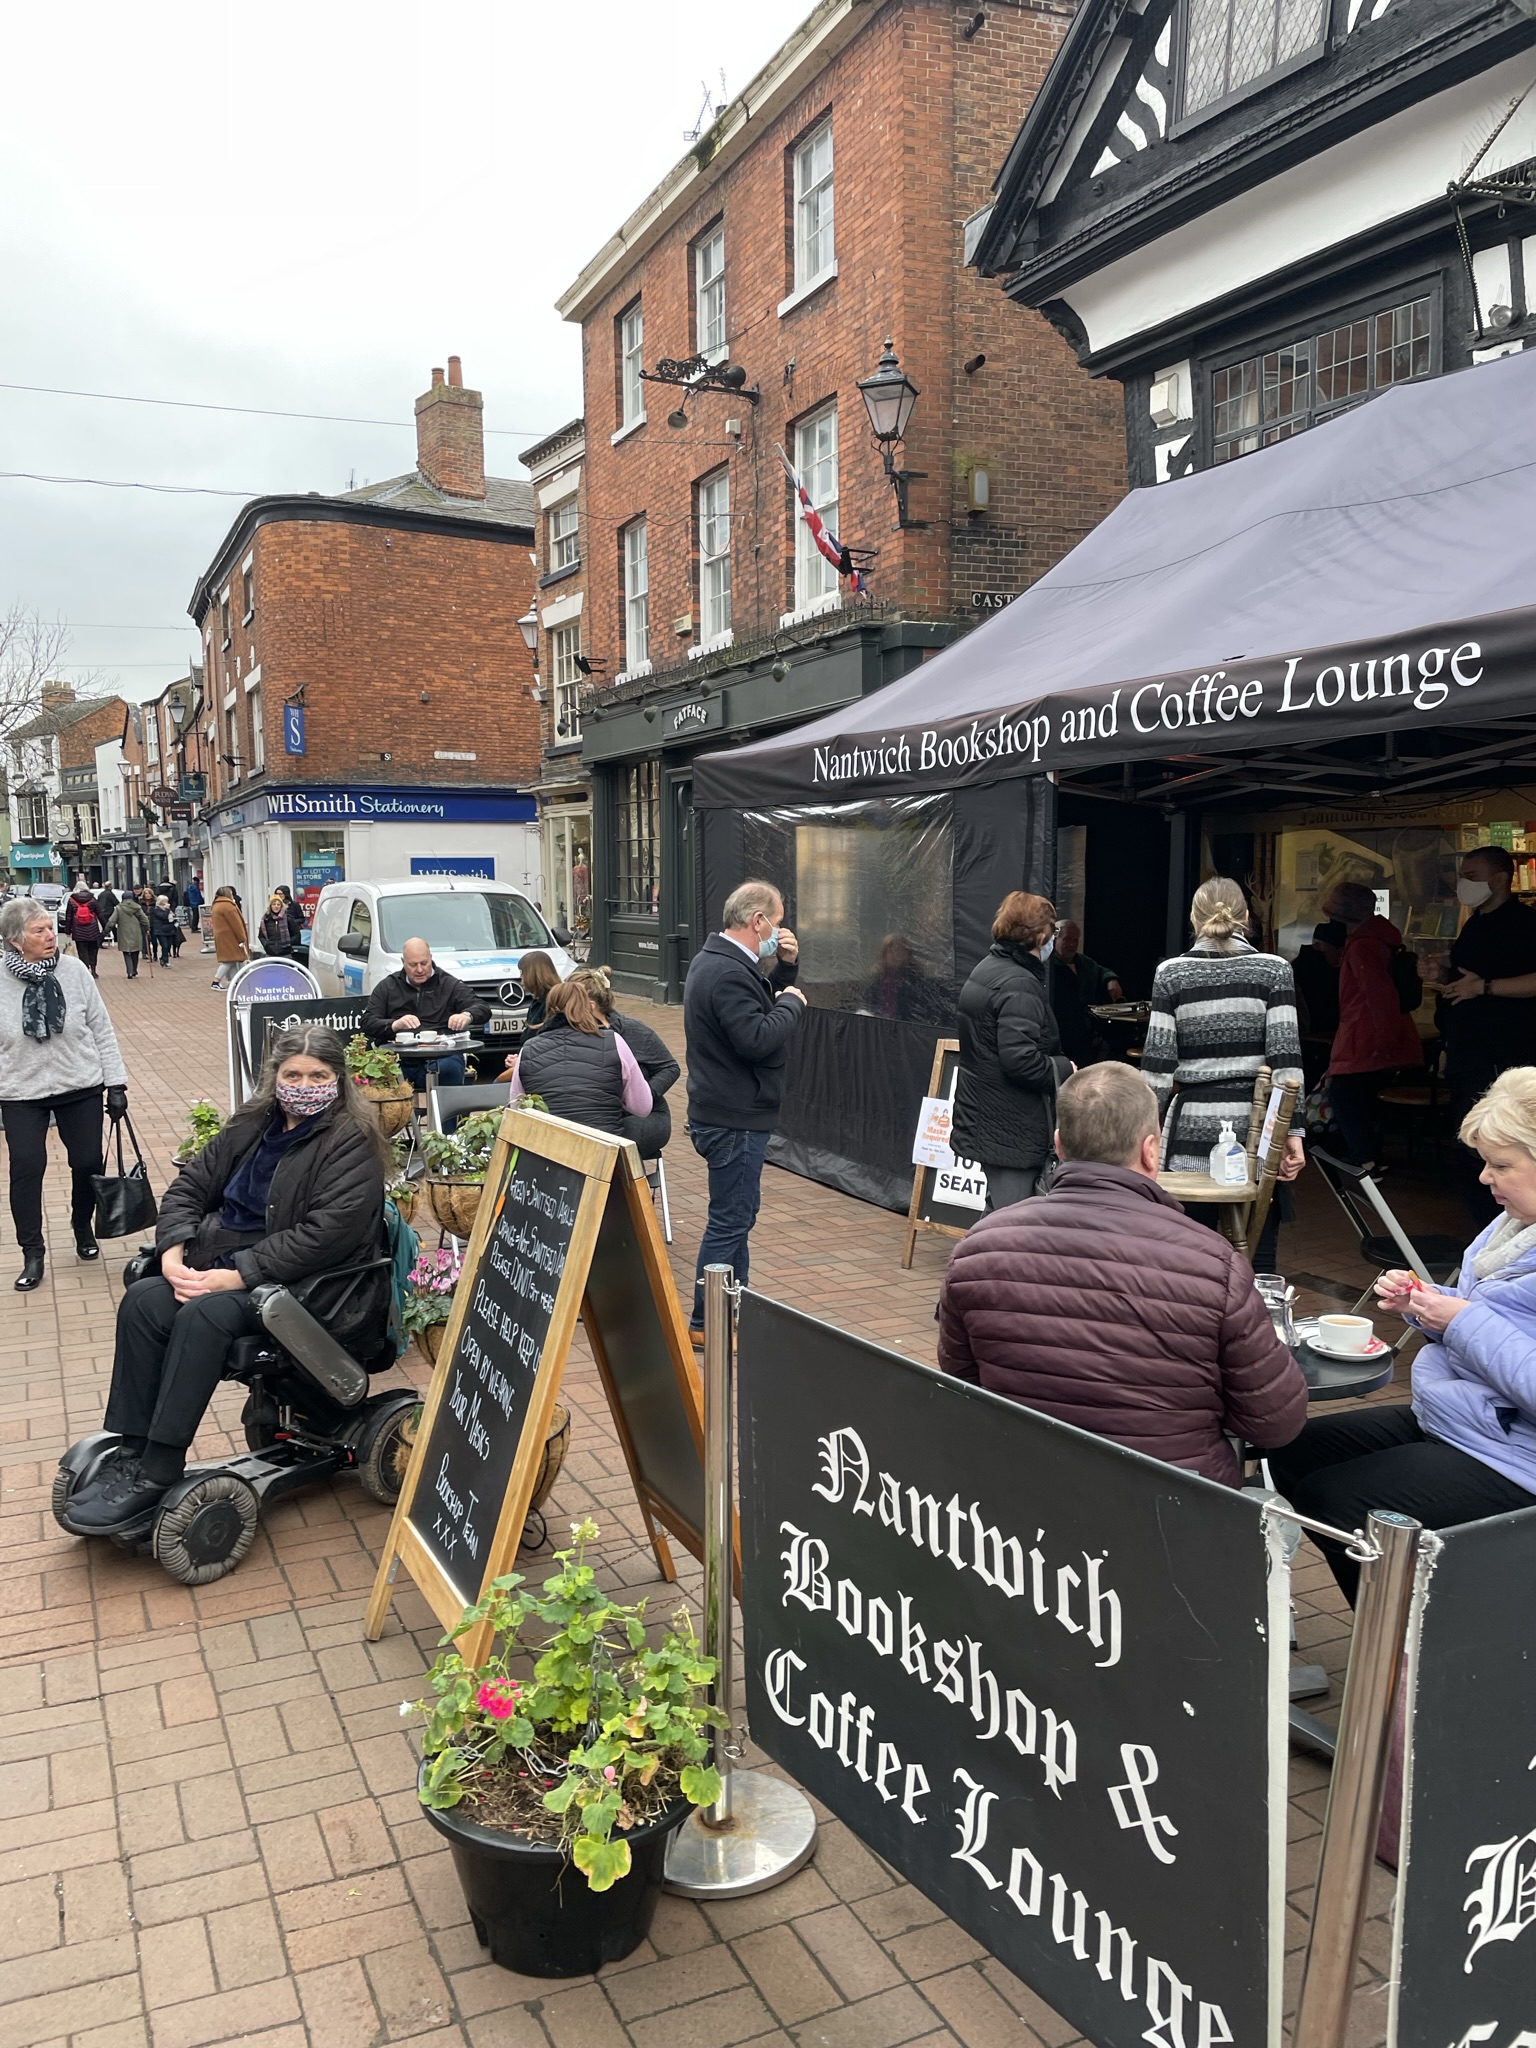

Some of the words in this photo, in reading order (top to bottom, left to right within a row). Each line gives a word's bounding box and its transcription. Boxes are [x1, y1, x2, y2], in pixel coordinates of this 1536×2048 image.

[972, 592, 1014, 608] CAST
[290, 716, 301, 746] S
[673, 704, 707, 730] FATFACE
[812, 733, 912, 783] Nantwich
[918, 712, 1051, 771] Bookshop
[1060, 688, 1122, 744] and
[1130, 670, 1264, 733] Coffee
[1276, 641, 1484, 713] Lounge
[266, 794, 357, 814] WHSmith
[358, 796, 443, 818] Stationery
[237, 994, 279, 1002] Methodist
[281, 992, 313, 1000] Church
[255, 986, 295, 994] Nantwich
[494, 1020, 518, 1032] DA19
[927, 1126, 947, 1136] Masks
[939, 1174, 985, 1196] SEAT
[556, 1186, 575, 1227] TABLE
[490, 1241, 512, 1280] PLEASE
[473, 1278, 501, 1331] PLEASE
[499, 1311, 519, 1347] HELP
[517, 1328, 535, 1369] KEEP
[461, 1325, 482, 1371] OPEN
[479, 1354, 492, 1384] BY
[449, 1369, 468, 1425] YOUR
[464, 1390, 490, 1461] MASKS
[462, 1490, 479, 1560] TEAM
[812, 1427, 1122, 1667] Nantwich
[779, 1521, 1077, 1801] Bookshop
[1107, 1743, 1179, 1865] &
[764, 1648, 932, 1825] Coffee
[951, 1768, 1234, 2048] Lounge
